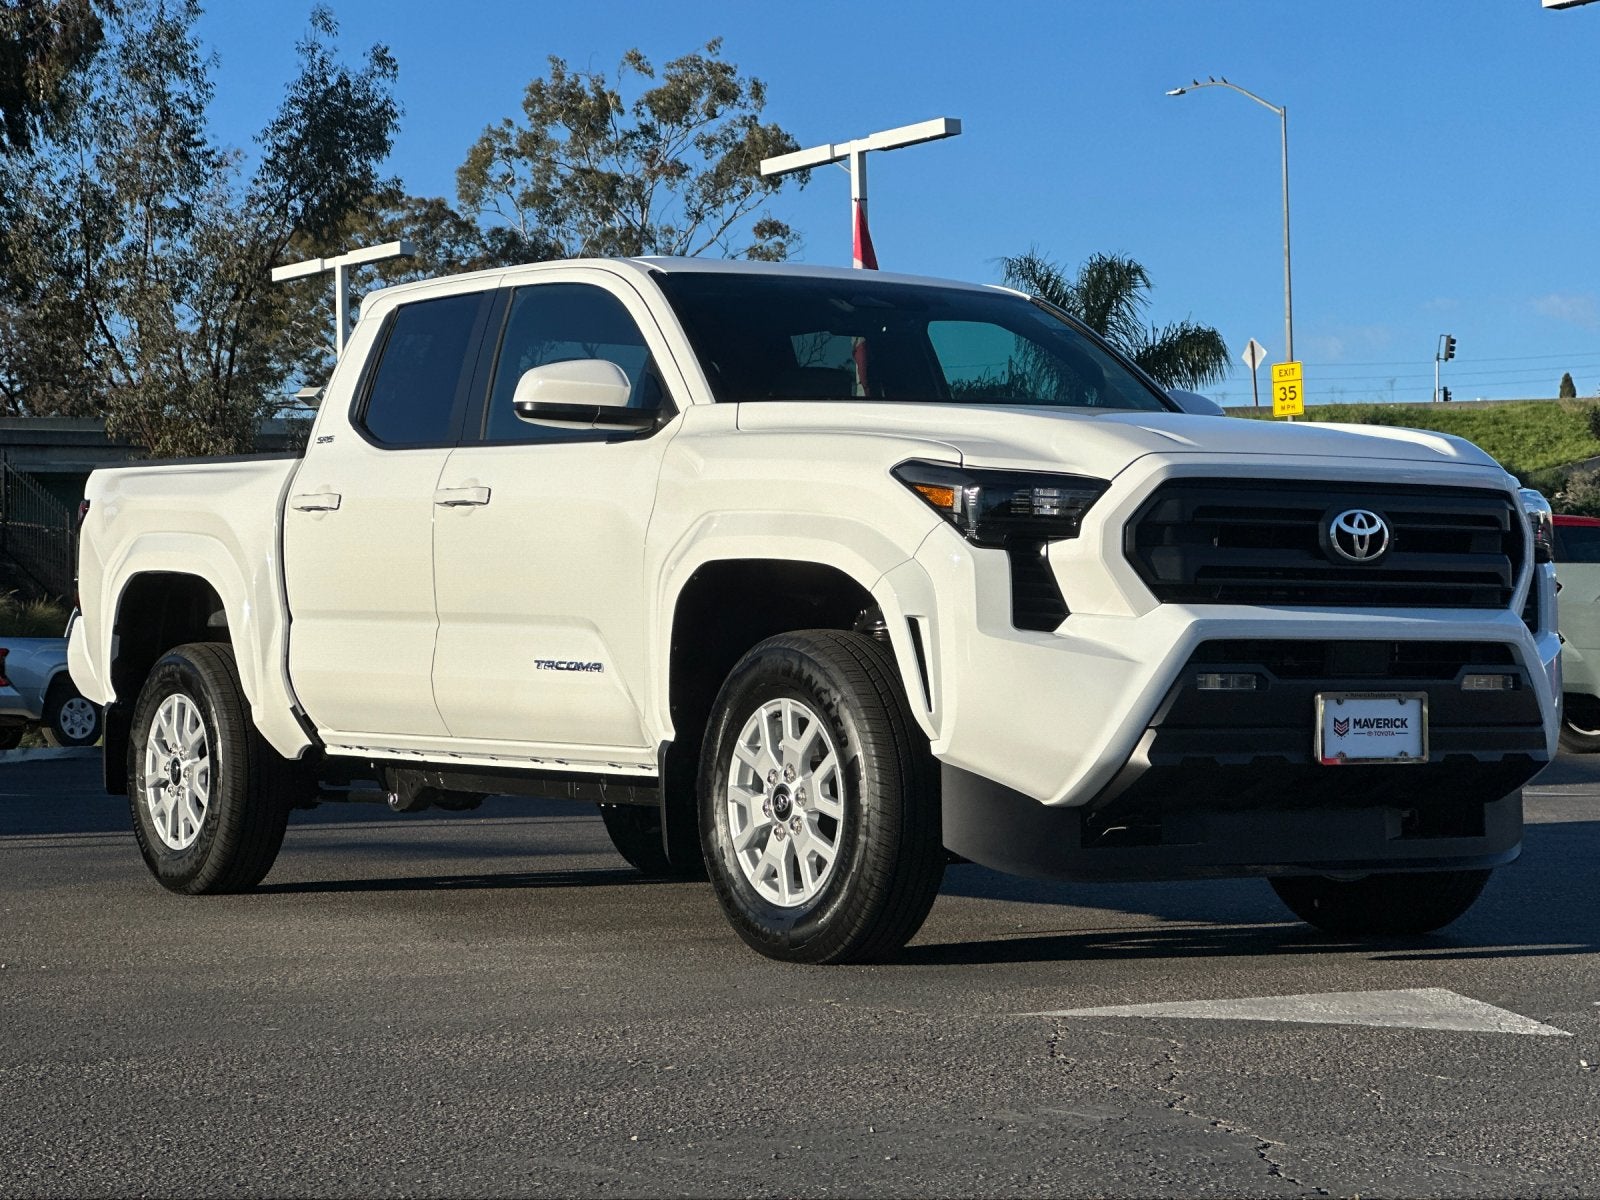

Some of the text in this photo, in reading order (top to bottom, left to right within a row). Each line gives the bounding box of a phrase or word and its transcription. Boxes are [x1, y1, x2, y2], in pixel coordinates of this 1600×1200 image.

[1278, 368, 1295, 377] EXIT
[1279, 386, 1297, 401] 35
[534, 660, 604, 673] TACOMA
[1353, 717, 1408, 729] MAVERICK
